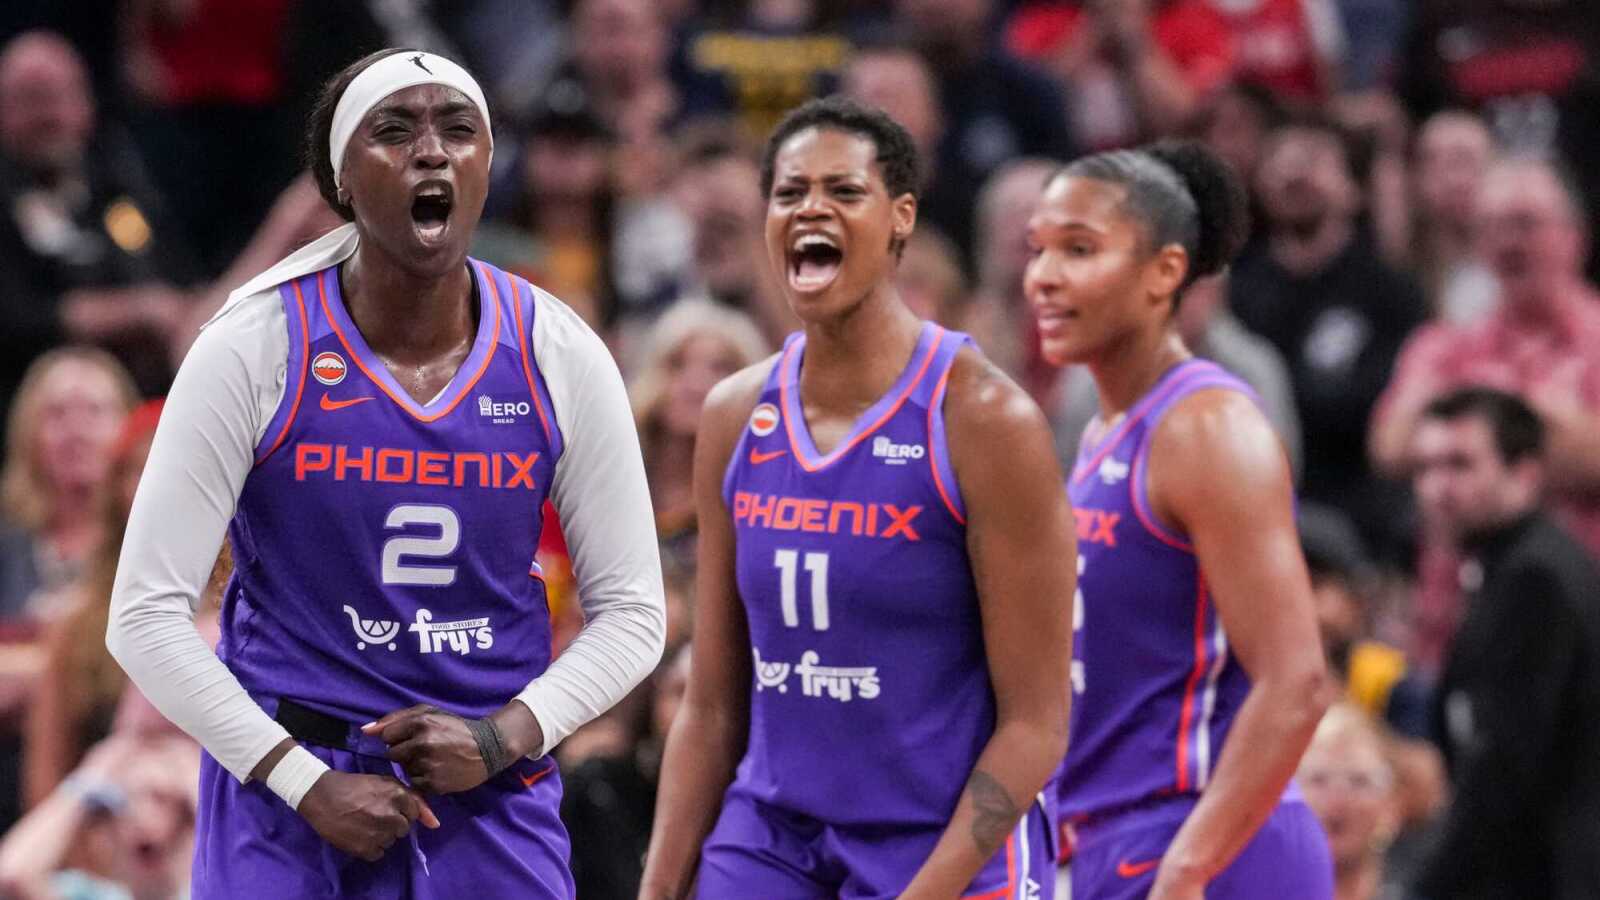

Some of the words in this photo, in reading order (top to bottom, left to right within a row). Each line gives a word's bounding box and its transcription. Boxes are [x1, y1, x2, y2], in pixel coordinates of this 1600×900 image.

[478, 395, 530, 416] HERO
[295, 443, 539, 489] PHOENIX
[734, 491, 922, 541] PHOENIX
[381, 503, 461, 586] 2
[774, 549, 829, 631] 11
[408, 608, 494, 656] fry's
[794, 650, 881, 702] fry's
